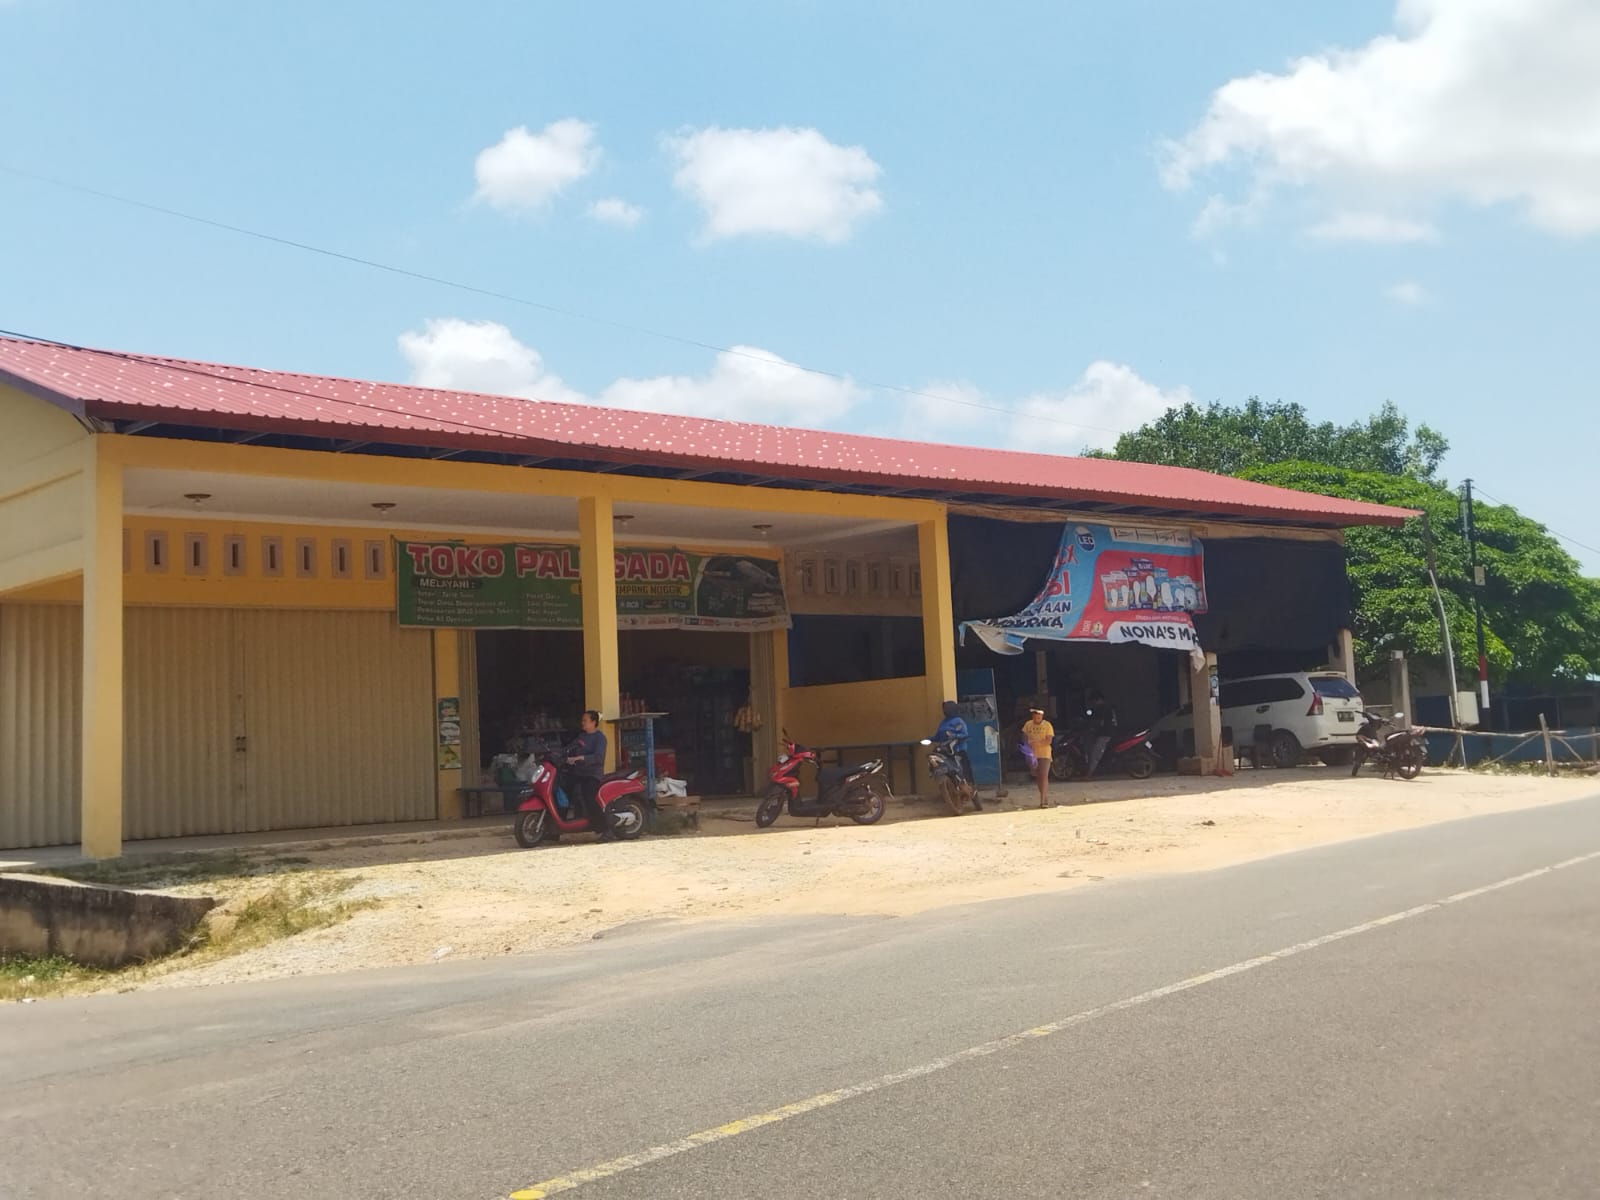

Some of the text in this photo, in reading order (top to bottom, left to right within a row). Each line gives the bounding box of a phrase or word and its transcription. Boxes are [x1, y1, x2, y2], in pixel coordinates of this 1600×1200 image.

[406, 543, 691, 583] TOKO PALGADA
[420, 579, 469, 589] MELAYANI
[1120, 625, 1177, 640] NONA'S
